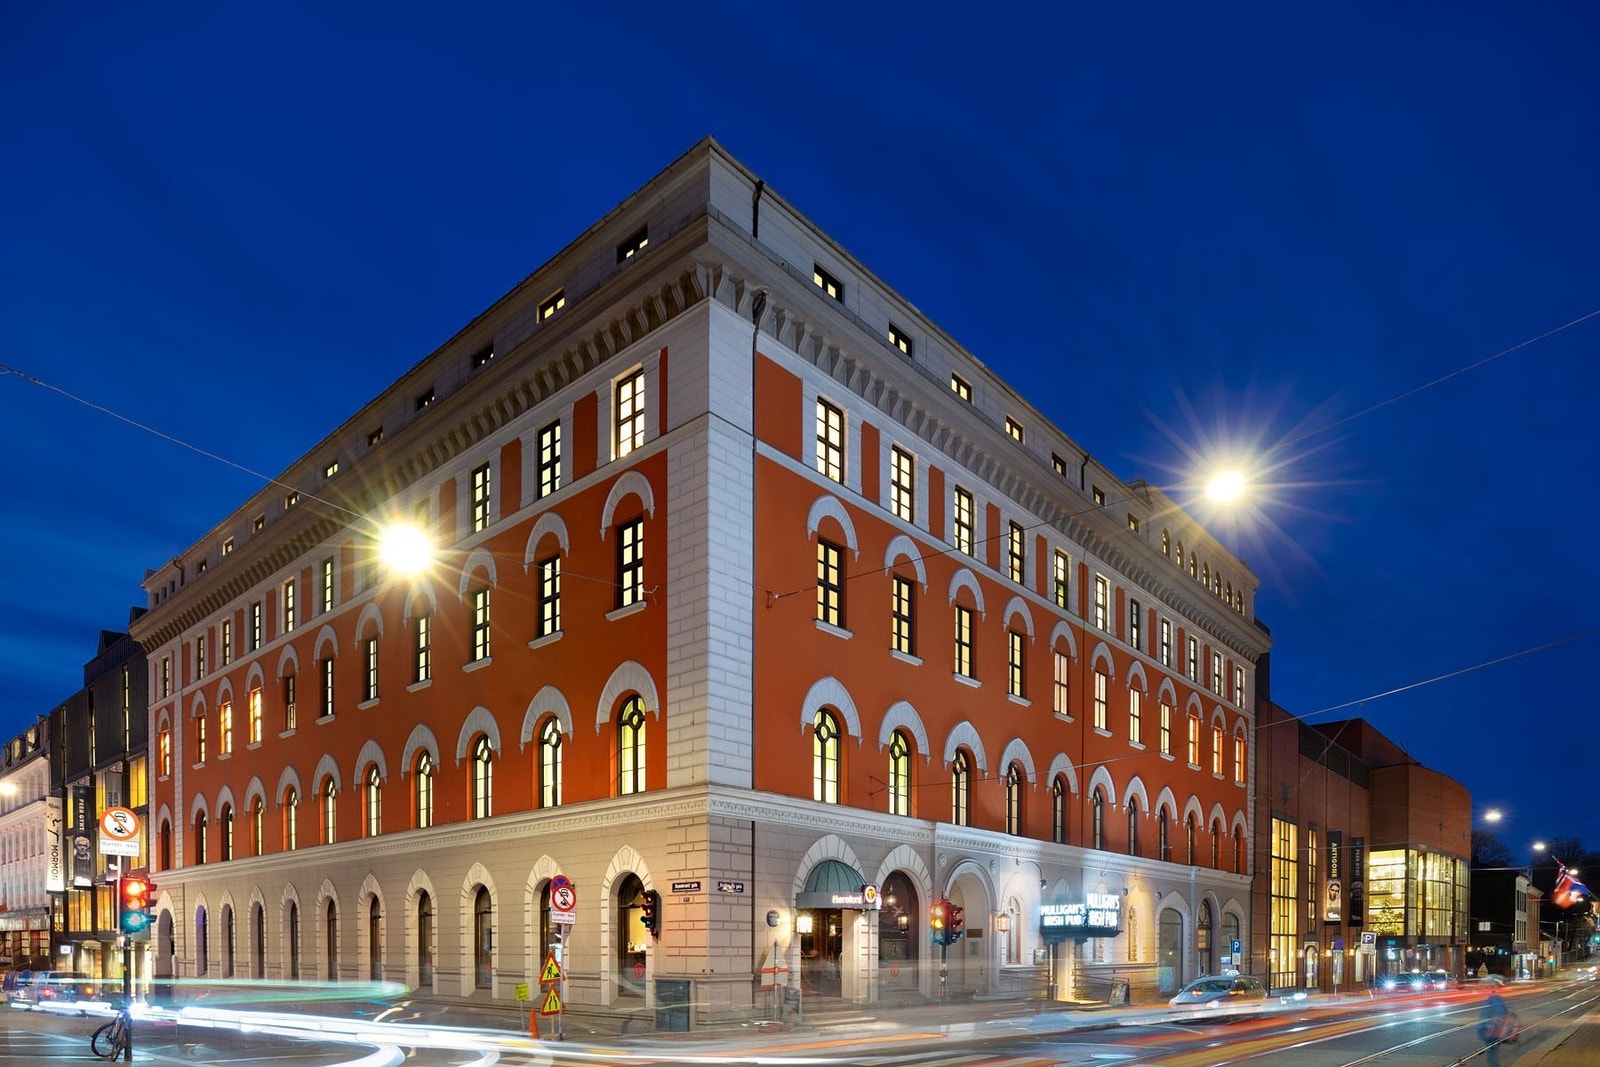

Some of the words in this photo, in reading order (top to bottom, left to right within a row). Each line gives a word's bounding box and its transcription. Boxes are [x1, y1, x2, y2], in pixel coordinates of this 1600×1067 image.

[51, 844, 59, 880] MORMON
[1086, 892, 1120, 910] MULLIGAN'S
[1040, 904, 1085, 915] MULLIGAN'S
[1044, 915, 1064, 926] IRISH
[1065, 915, 1082, 926] PUB
[1089, 911, 1104, 926] IRISH
[1105, 911, 1118, 927] PUB
[1365, 935, 1372, 943] P
[1234, 941, 1240, 951] P
